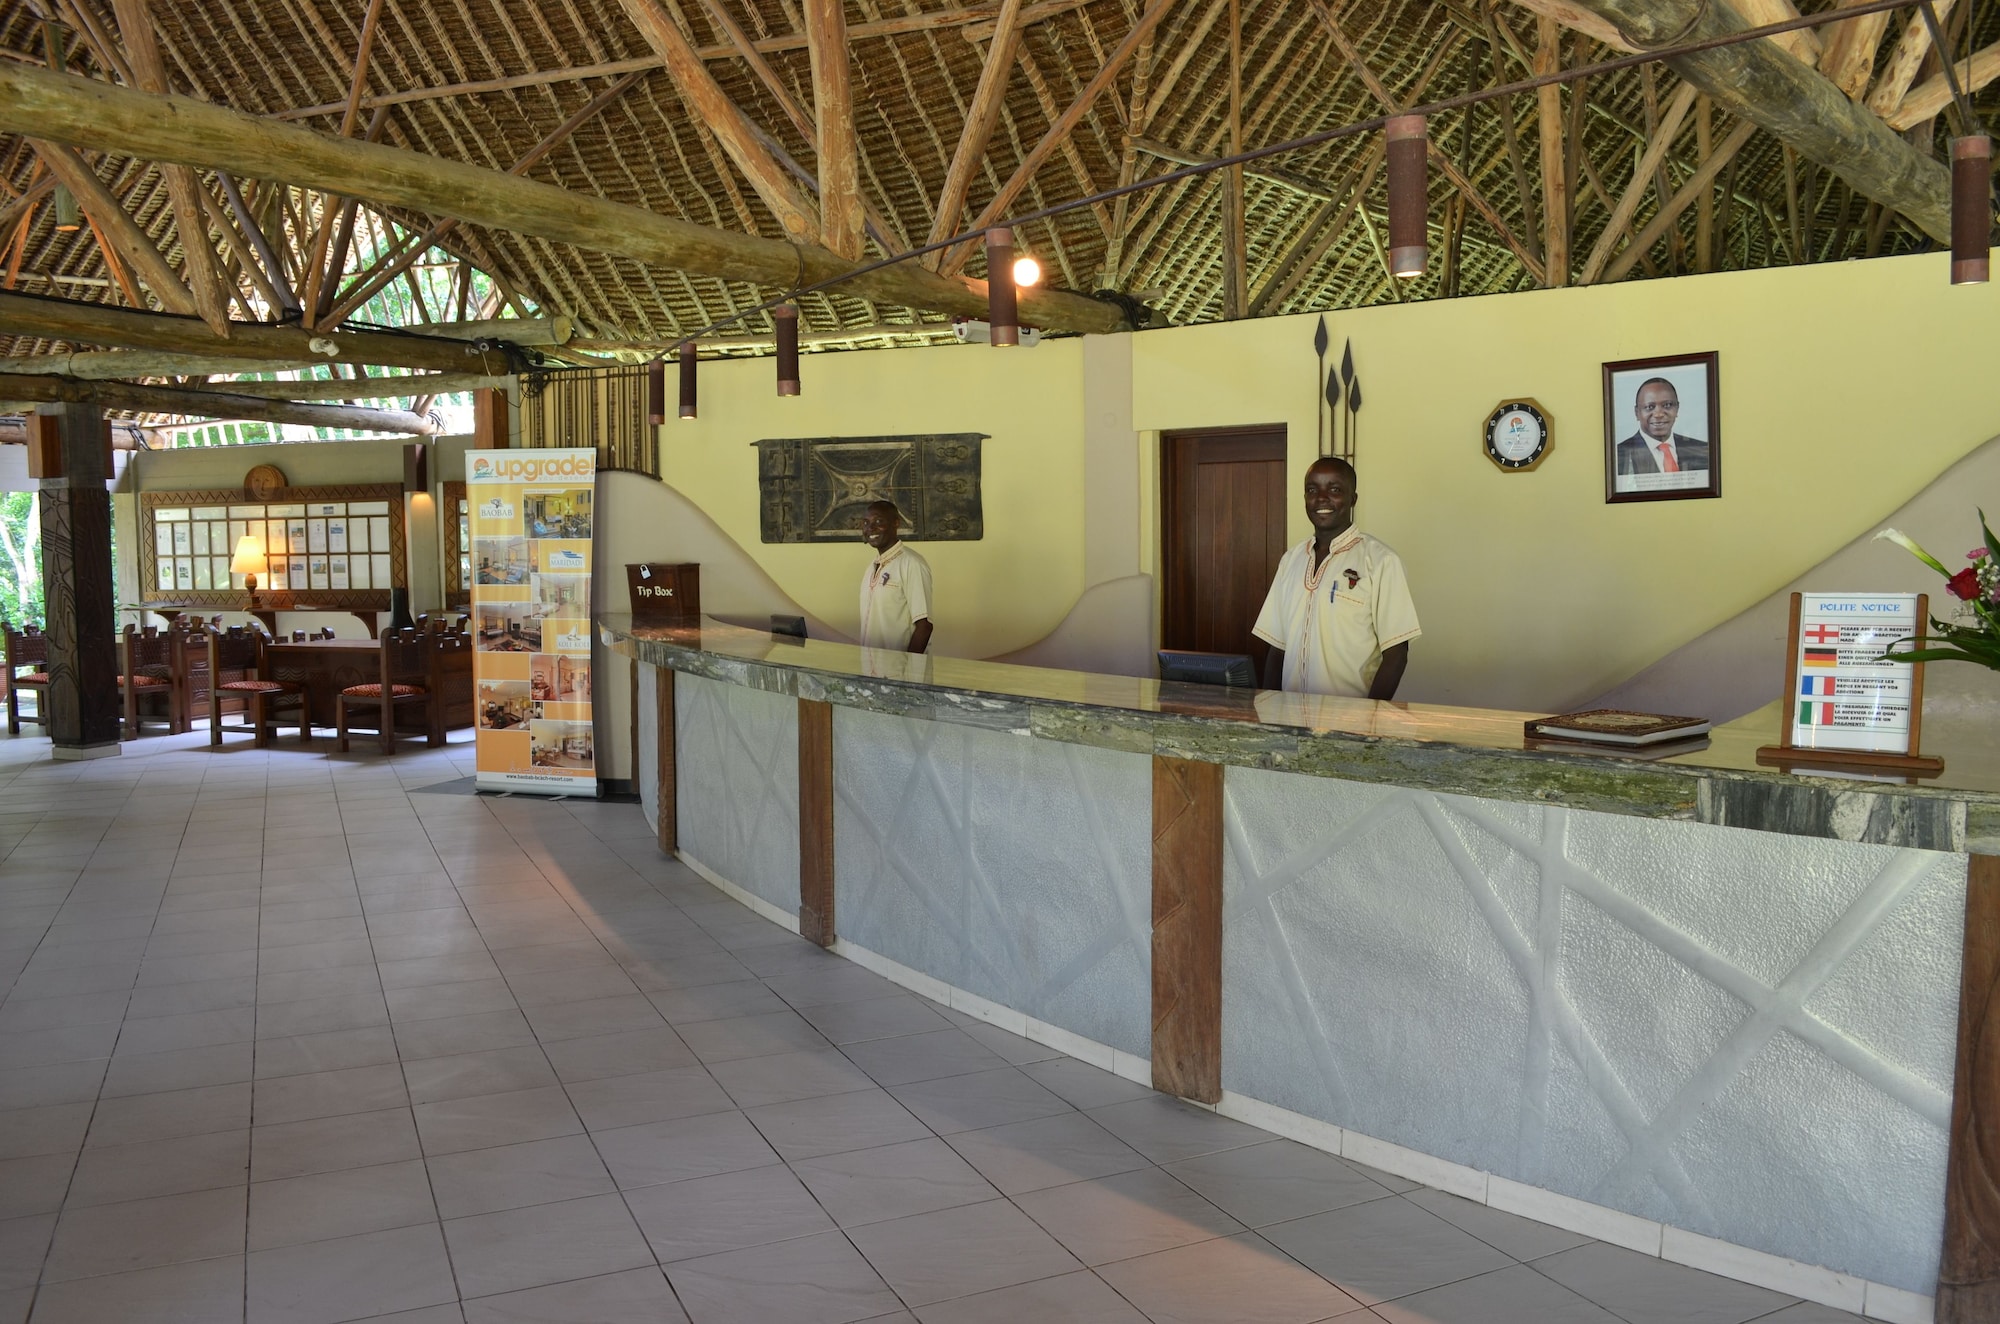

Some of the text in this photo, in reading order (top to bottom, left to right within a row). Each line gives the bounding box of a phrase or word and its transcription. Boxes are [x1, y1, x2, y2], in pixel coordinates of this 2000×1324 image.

[495, 454, 594, 482] upgrade!
[636, 586, 673, 598] Tip Box
[1820, 603, 1900, 612] POLITE NOTICE
[506, 774, 573, 782] www.baobab-beach-resort.com
